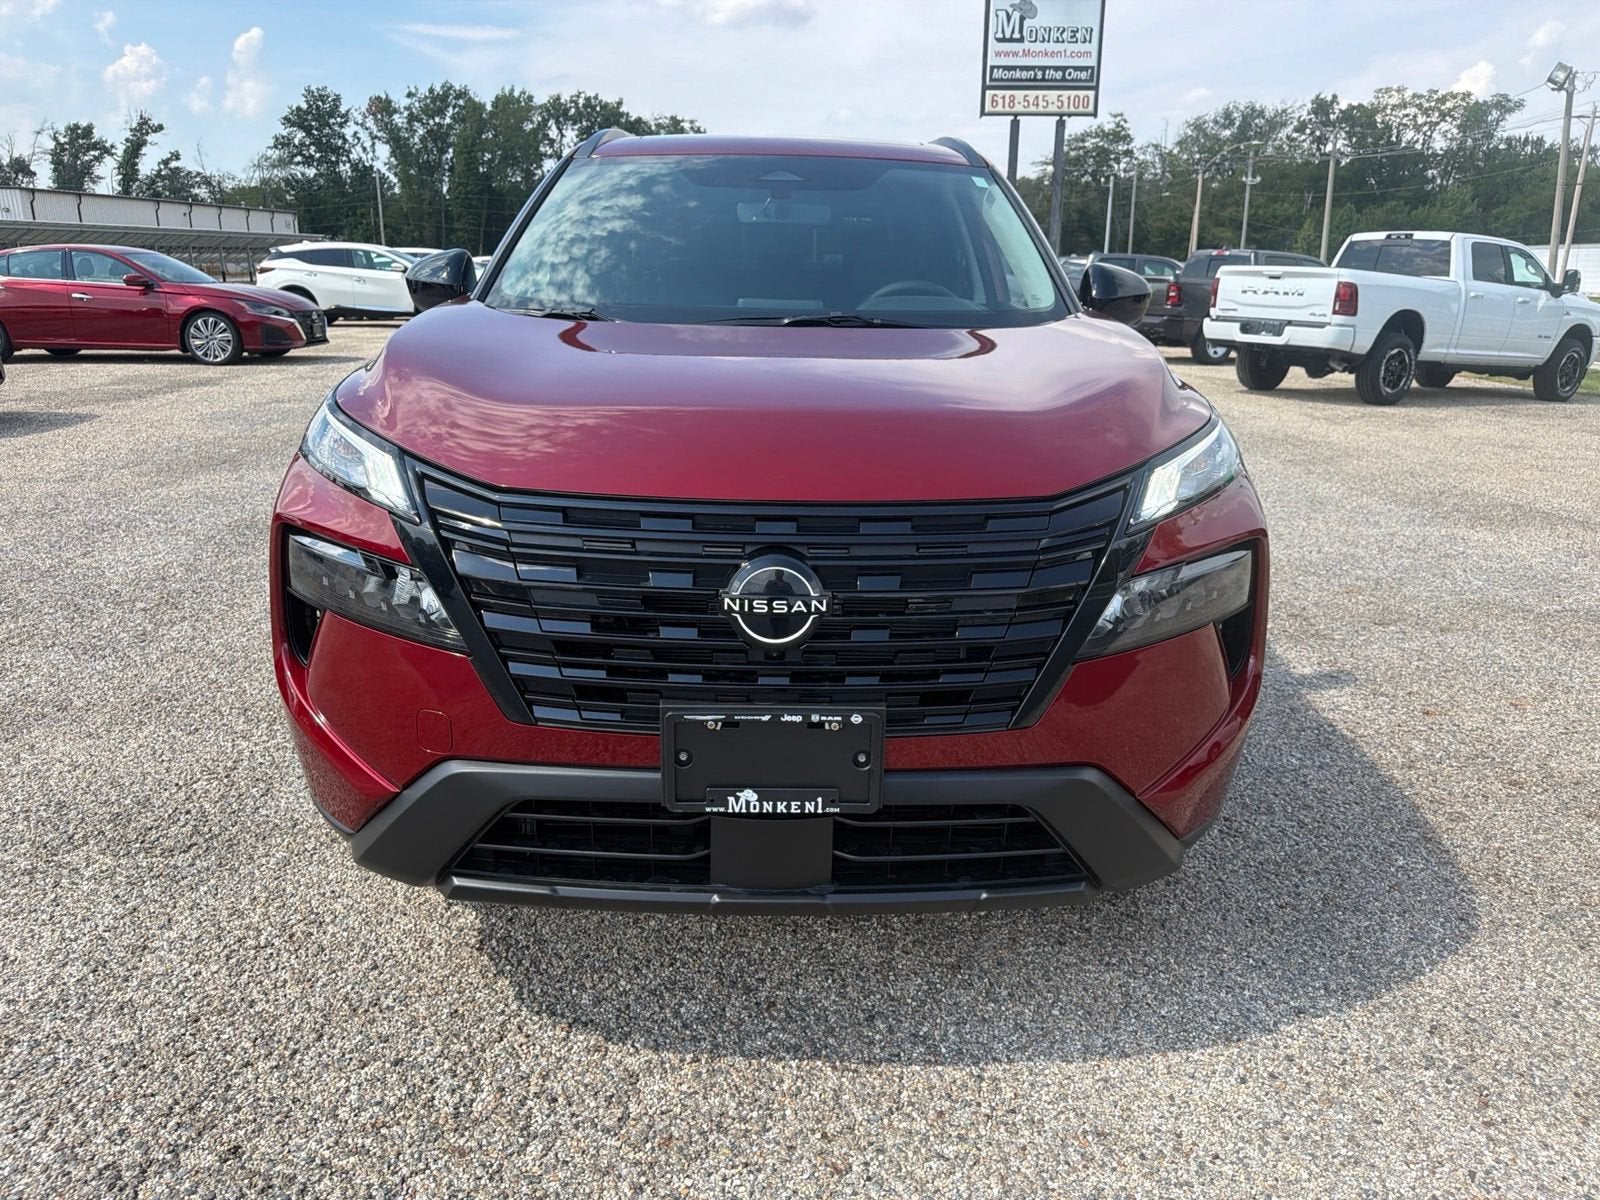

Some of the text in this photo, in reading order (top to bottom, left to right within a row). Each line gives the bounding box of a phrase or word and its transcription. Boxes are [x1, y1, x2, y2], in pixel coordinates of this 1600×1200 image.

[994, 49, 1092, 59] www.Monken1.com
[992, 68, 1091, 80] Monken's the One!
[991, 94, 1090, 109] 618-545-5100
[724, 597, 827, 613] NISSAN
[781, 714, 803, 723] Jeep
